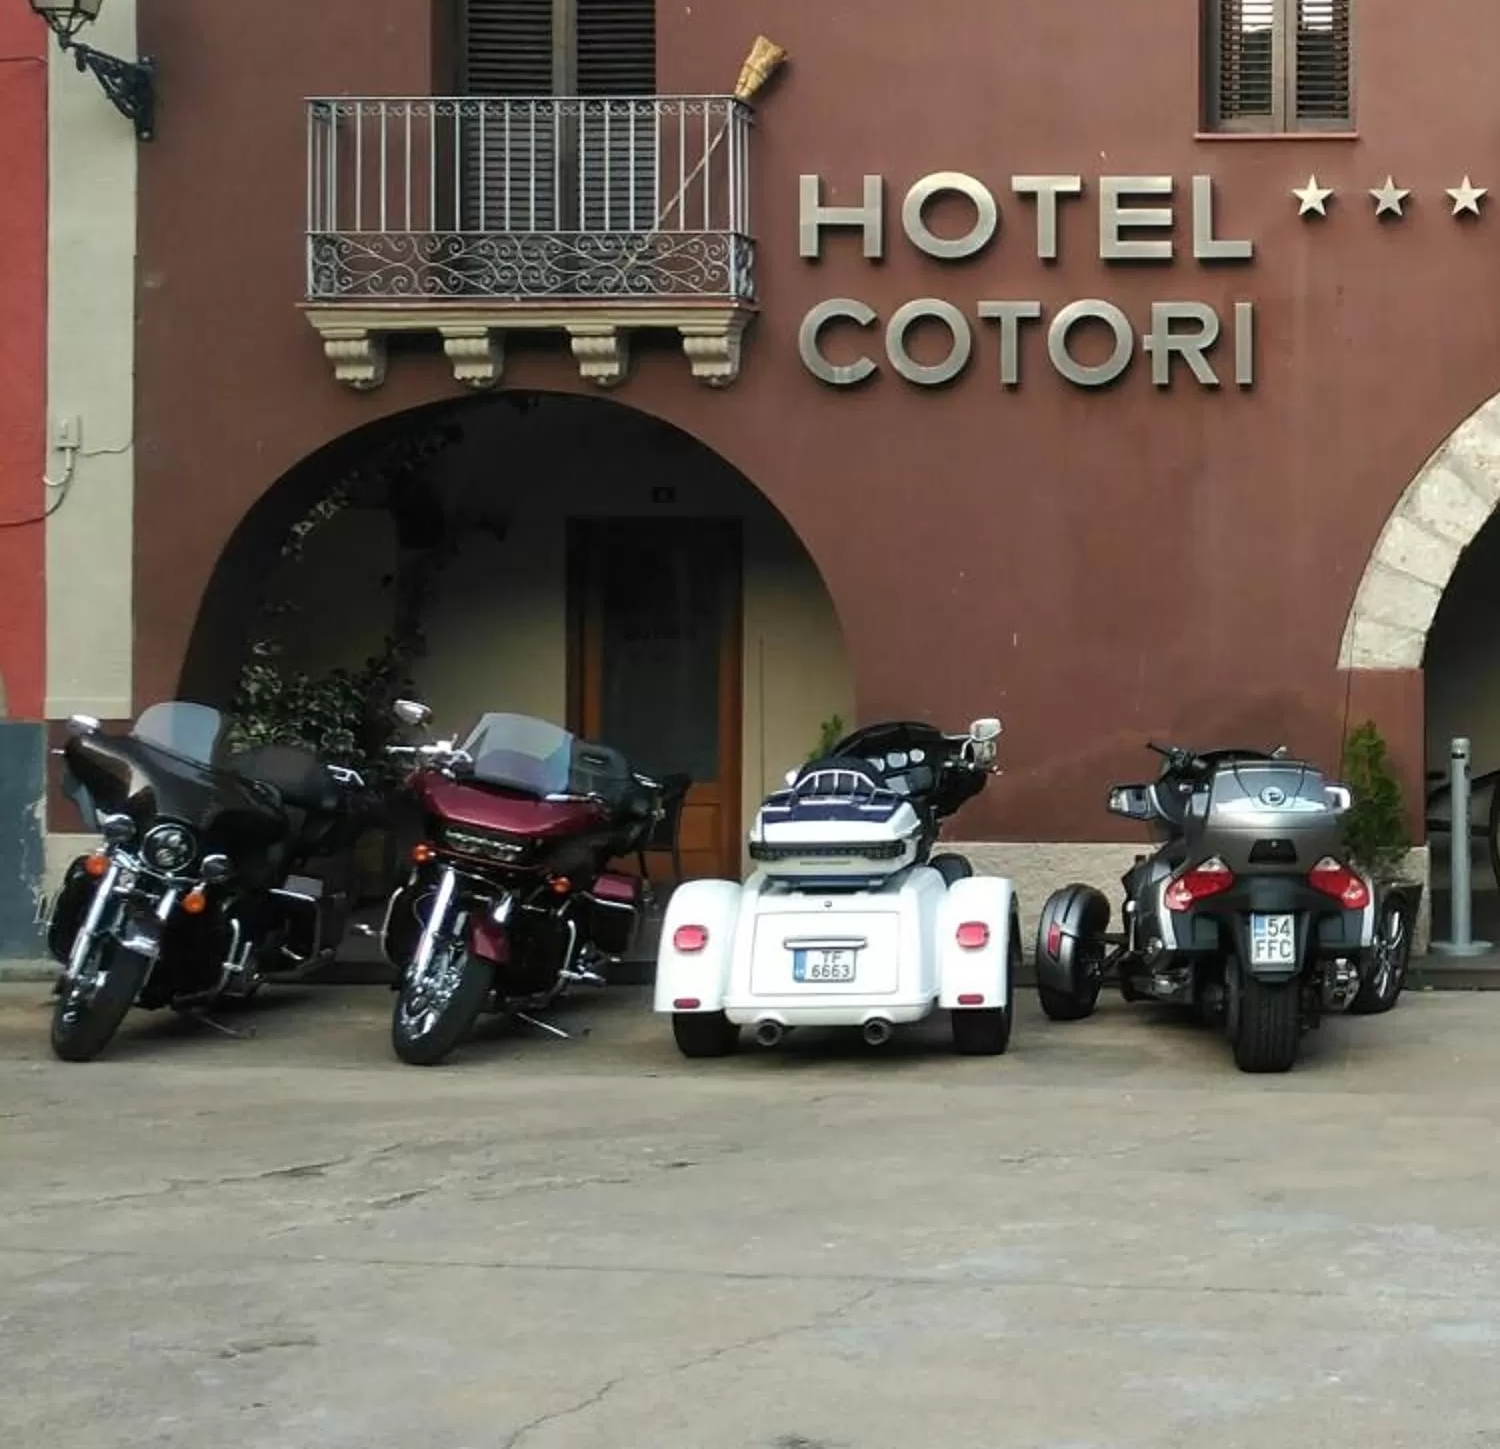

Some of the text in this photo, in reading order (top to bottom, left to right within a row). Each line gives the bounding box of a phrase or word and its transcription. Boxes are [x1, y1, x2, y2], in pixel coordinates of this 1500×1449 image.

[800, 172, 1253, 260] HOTEL
[800, 298, 1254, 387] COTORI
[1256, 939, 1292, 959] FFC
[1268, 918, 1290, 937] 54
